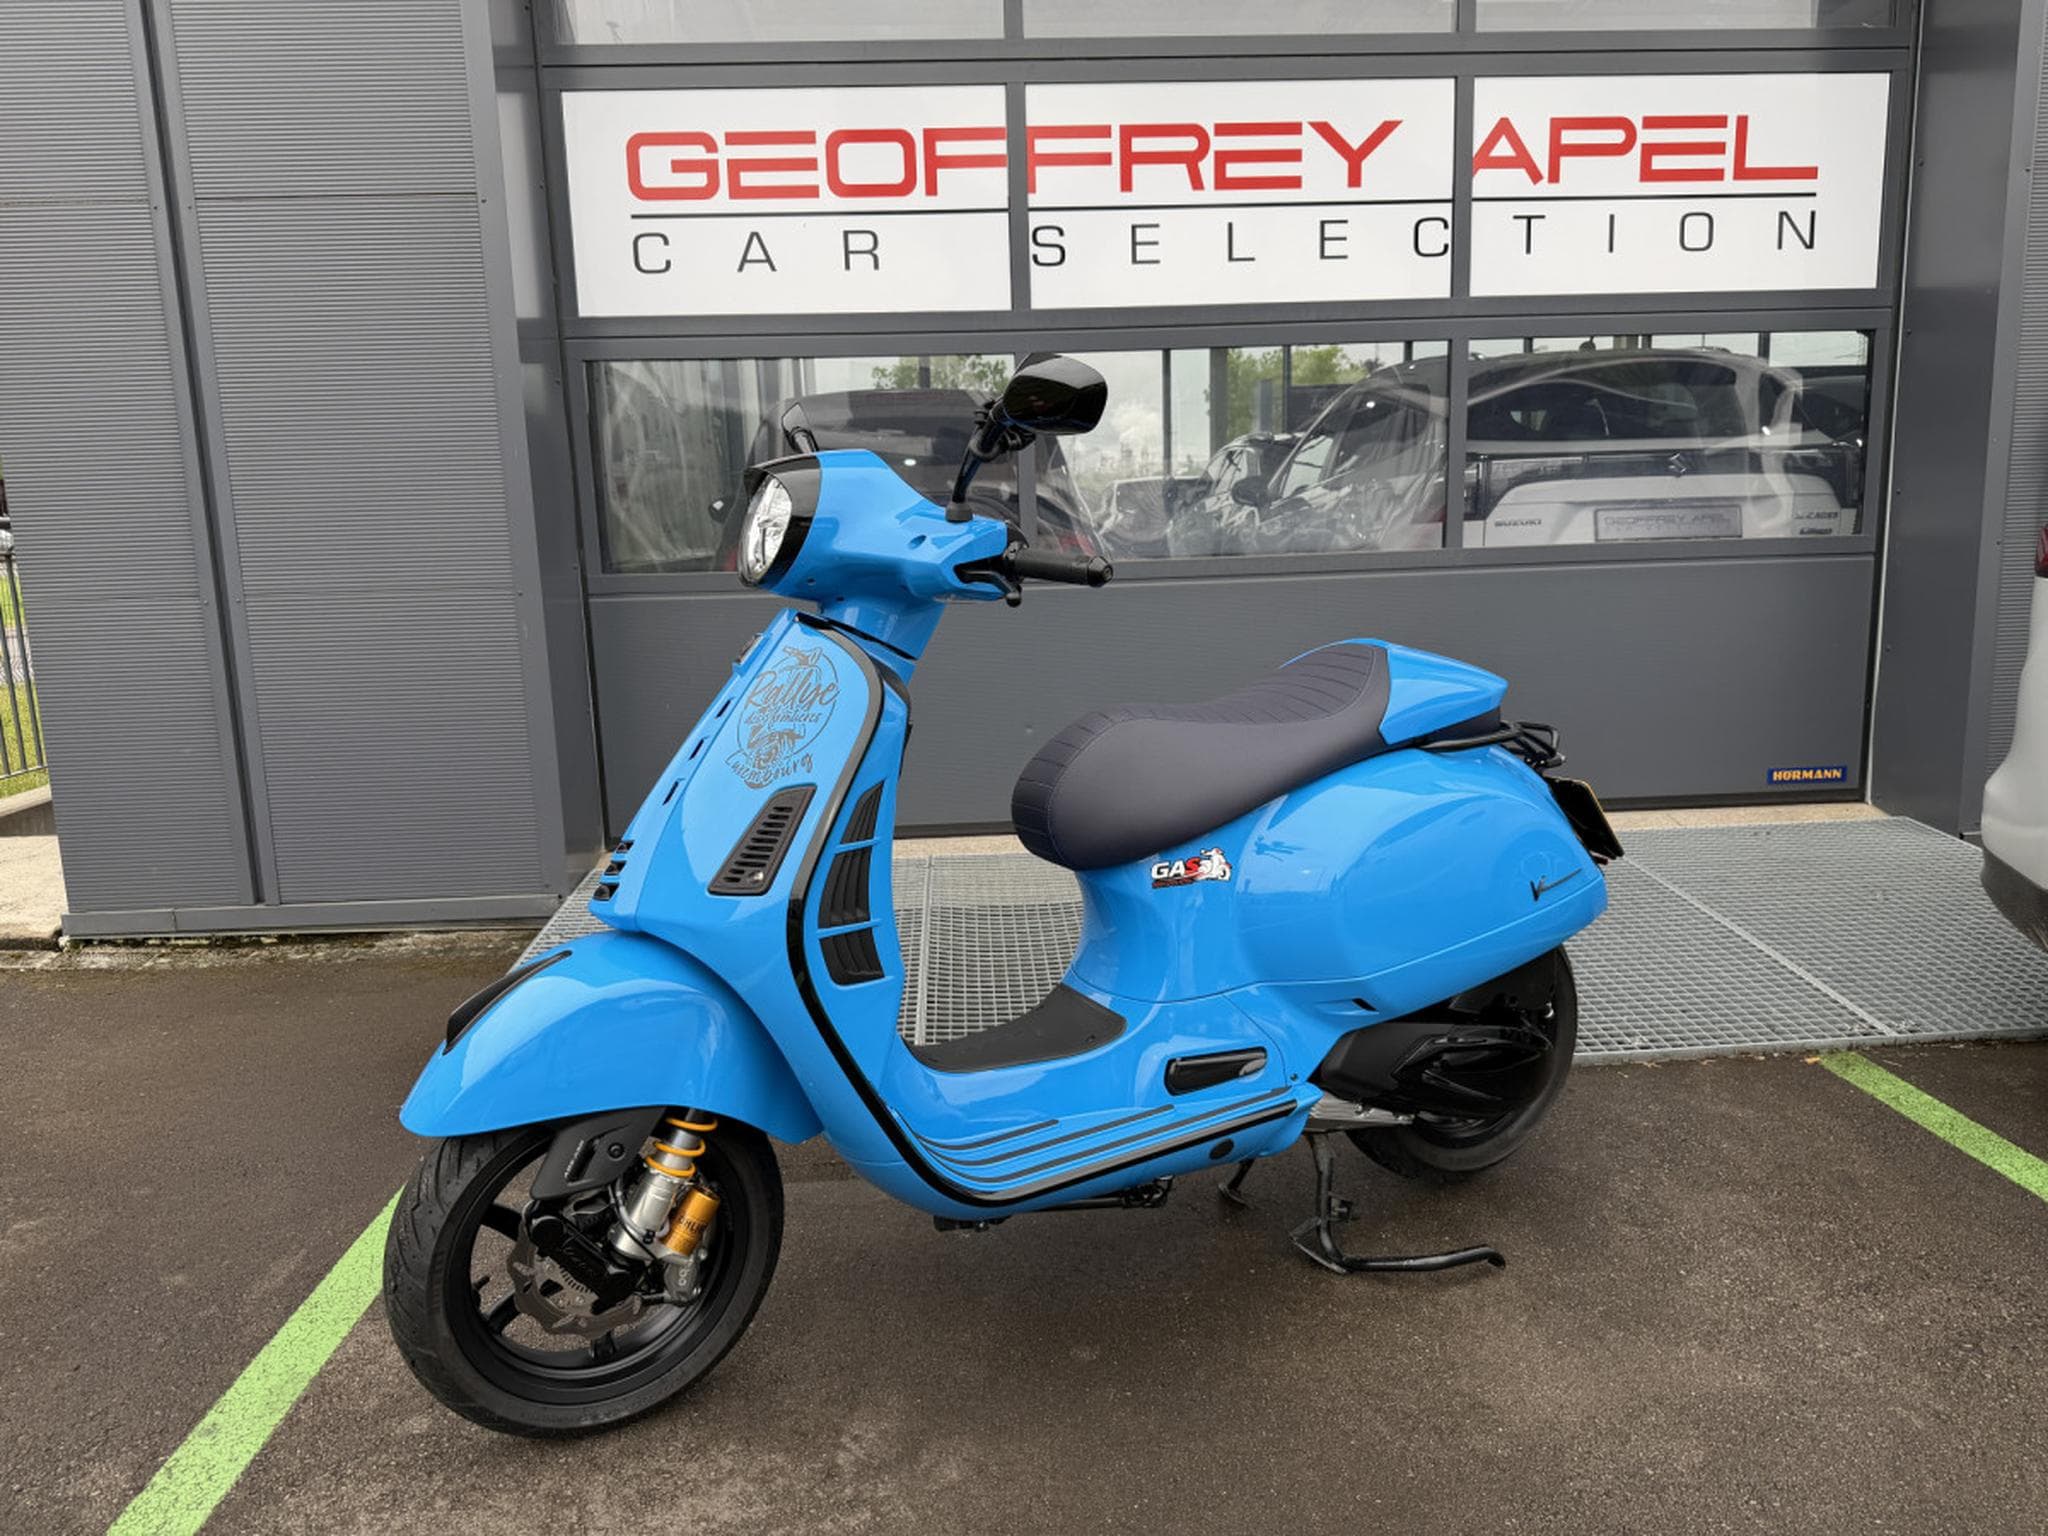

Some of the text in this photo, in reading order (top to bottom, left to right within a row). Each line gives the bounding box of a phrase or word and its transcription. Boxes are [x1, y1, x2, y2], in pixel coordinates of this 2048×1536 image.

[626, 115, 1818, 200] GEOFFREY APEL
[632, 210, 1817, 274] CAR SELECTION
[744, 670, 840, 710] Rallye
